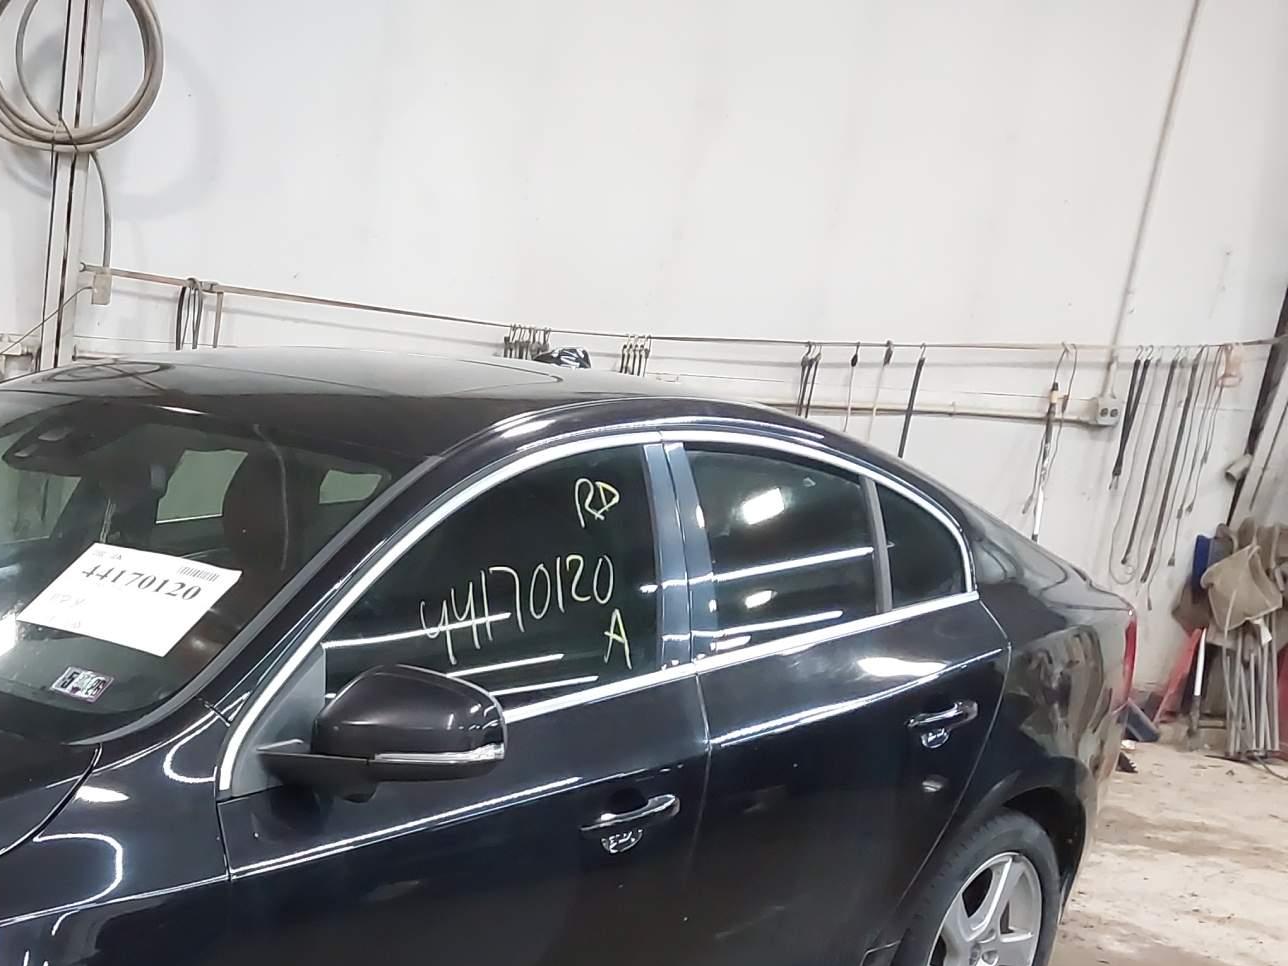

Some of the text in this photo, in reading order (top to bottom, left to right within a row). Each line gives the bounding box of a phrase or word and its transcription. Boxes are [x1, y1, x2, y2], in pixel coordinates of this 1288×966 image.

[81, 564, 203, 601] 44170120
[419, 554, 614, 666] 44170120
[603, 608, 633, 670] A
